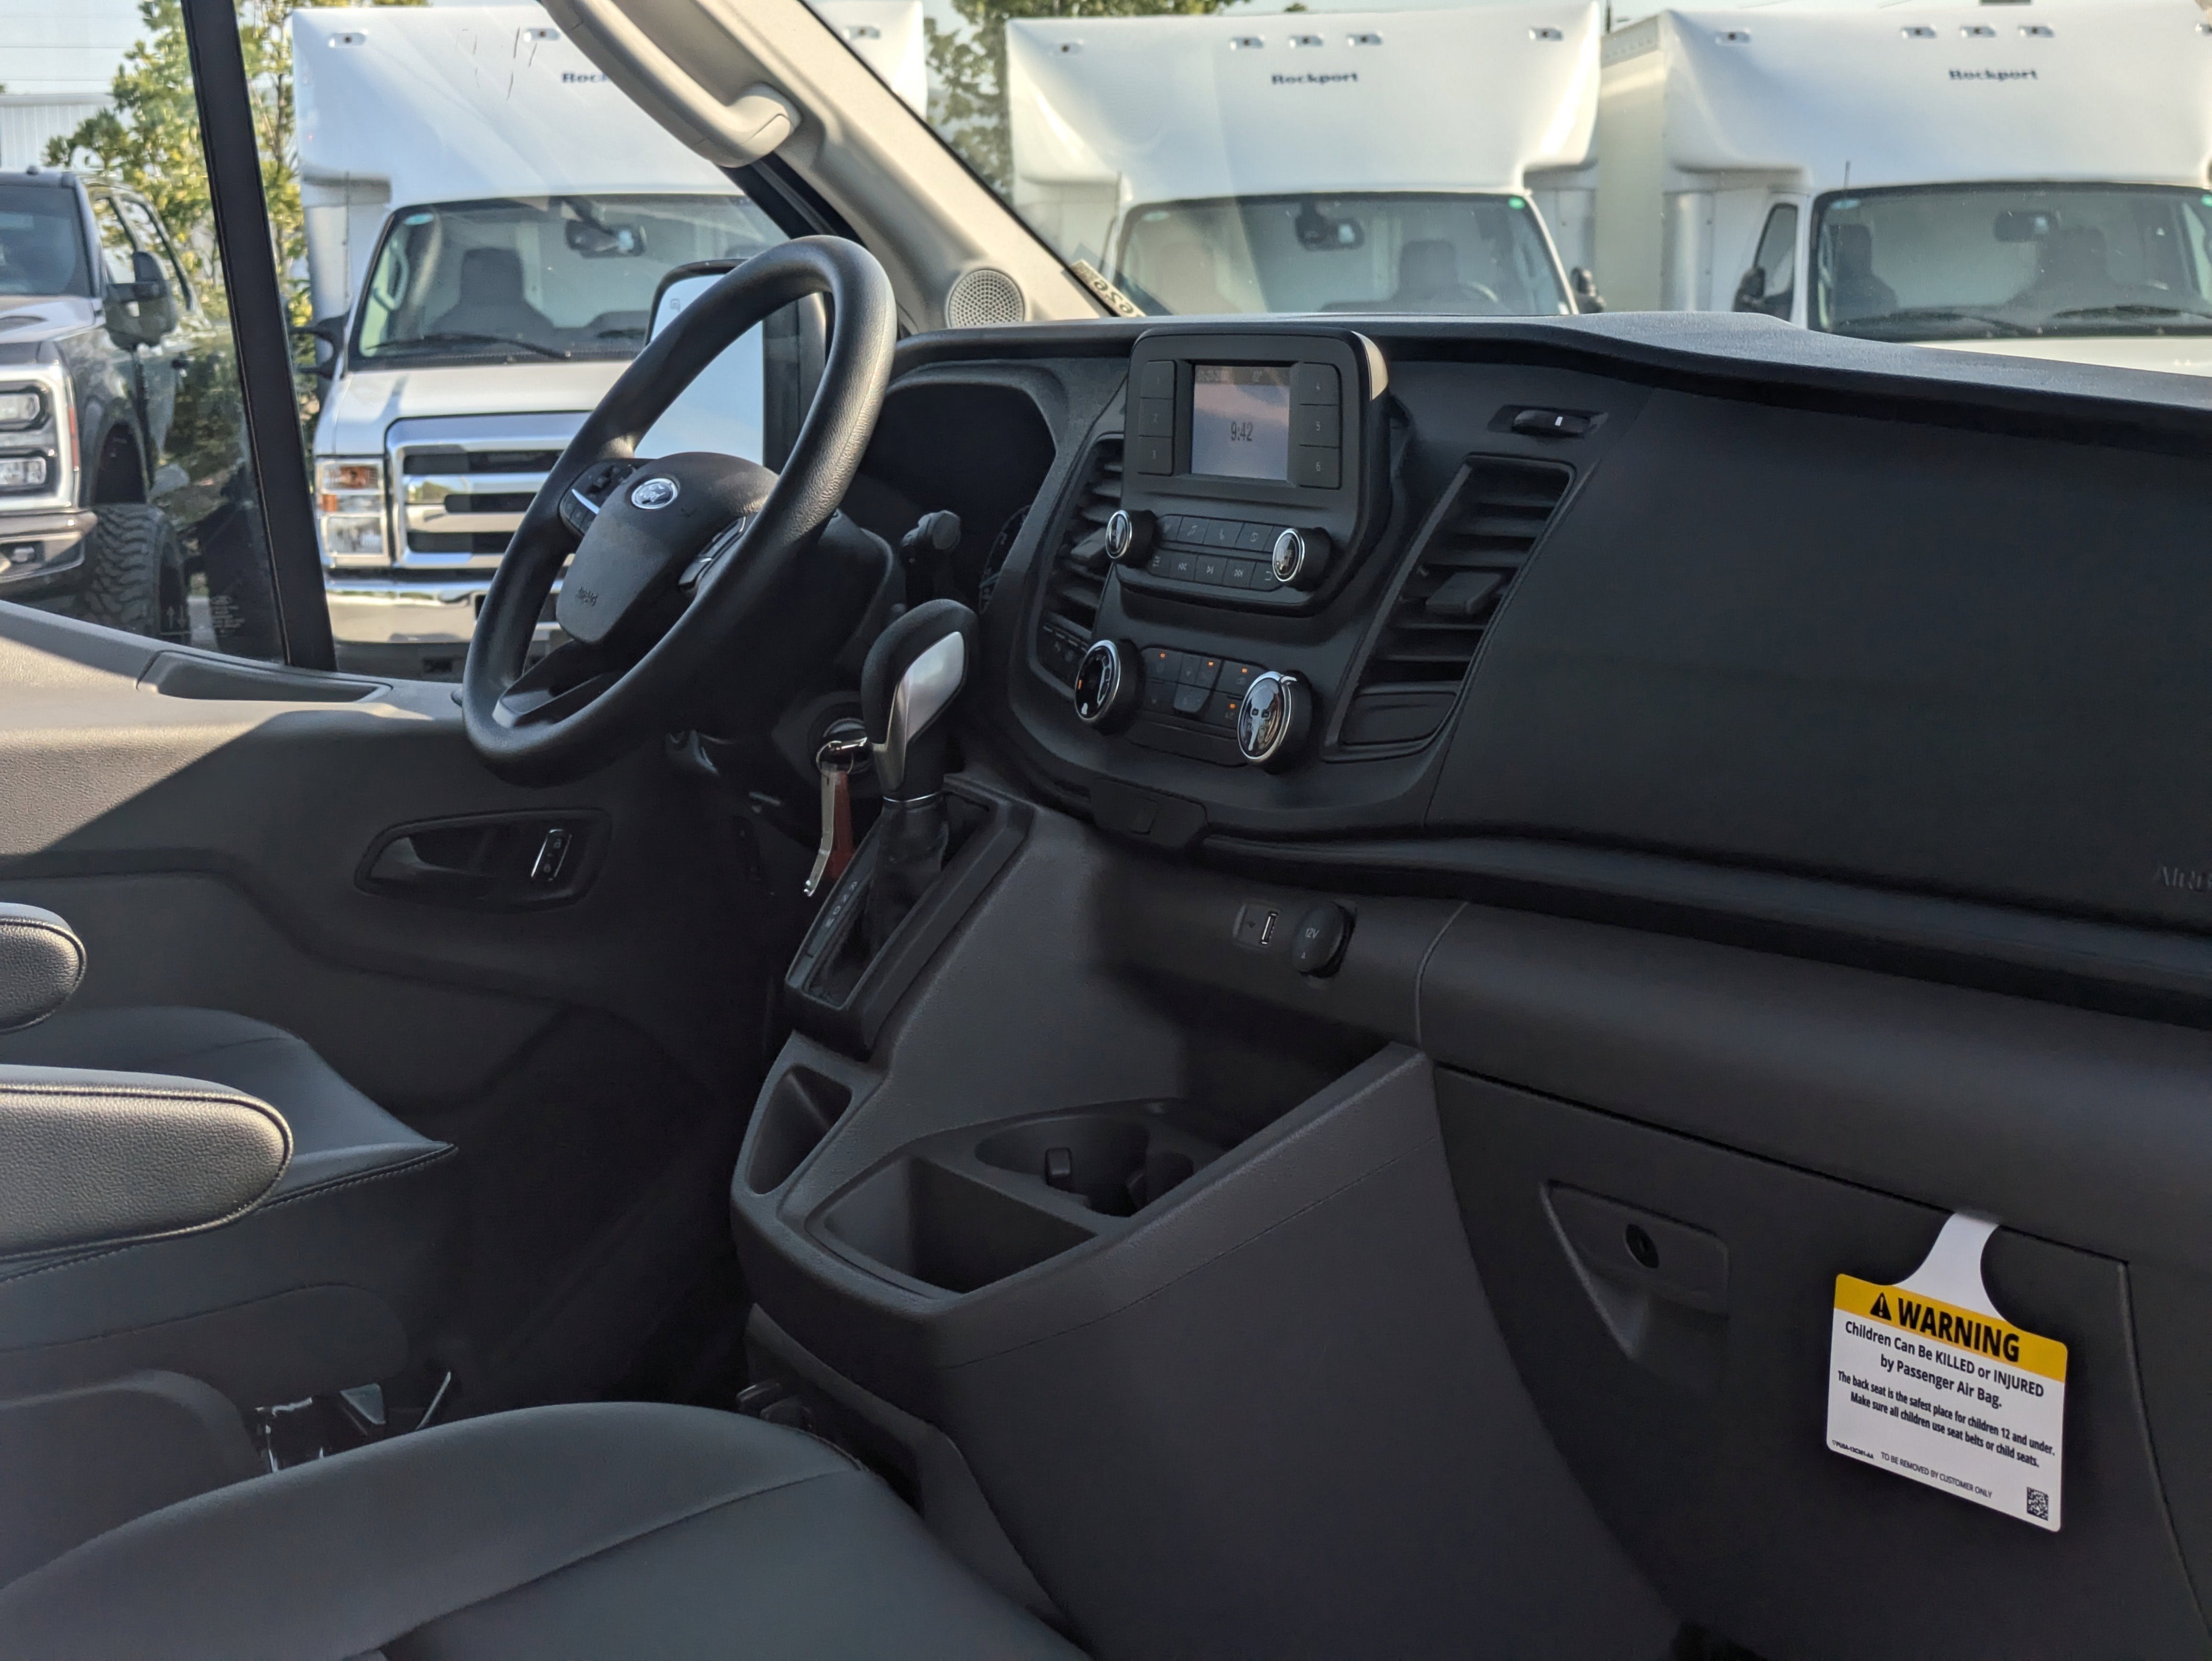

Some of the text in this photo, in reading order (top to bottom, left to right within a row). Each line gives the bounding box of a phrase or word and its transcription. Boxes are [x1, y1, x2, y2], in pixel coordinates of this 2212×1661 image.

[1272, 73, 1358, 85] Rockport
[1948, 69, 2038, 81] Rockport
[1230, 421, 1253, 441] 9:42
[1898, 1297, 2019, 1362] WARNING
[1845, 1320, 2044, 1397] Children Can Be KILLED or INJURED
[1880, 1353, 2002, 1409] by Passenger Air Bag.
[1837, 1370, 2055, 1456] The back seat is the safest place for children 12 and under.
[1850, 1391, 2039, 1468] Make sure all children use seat belts or child seats.
[1880, 1451, 1992, 1498] TO BE REMOVED BY CUSTOMER ONLY
